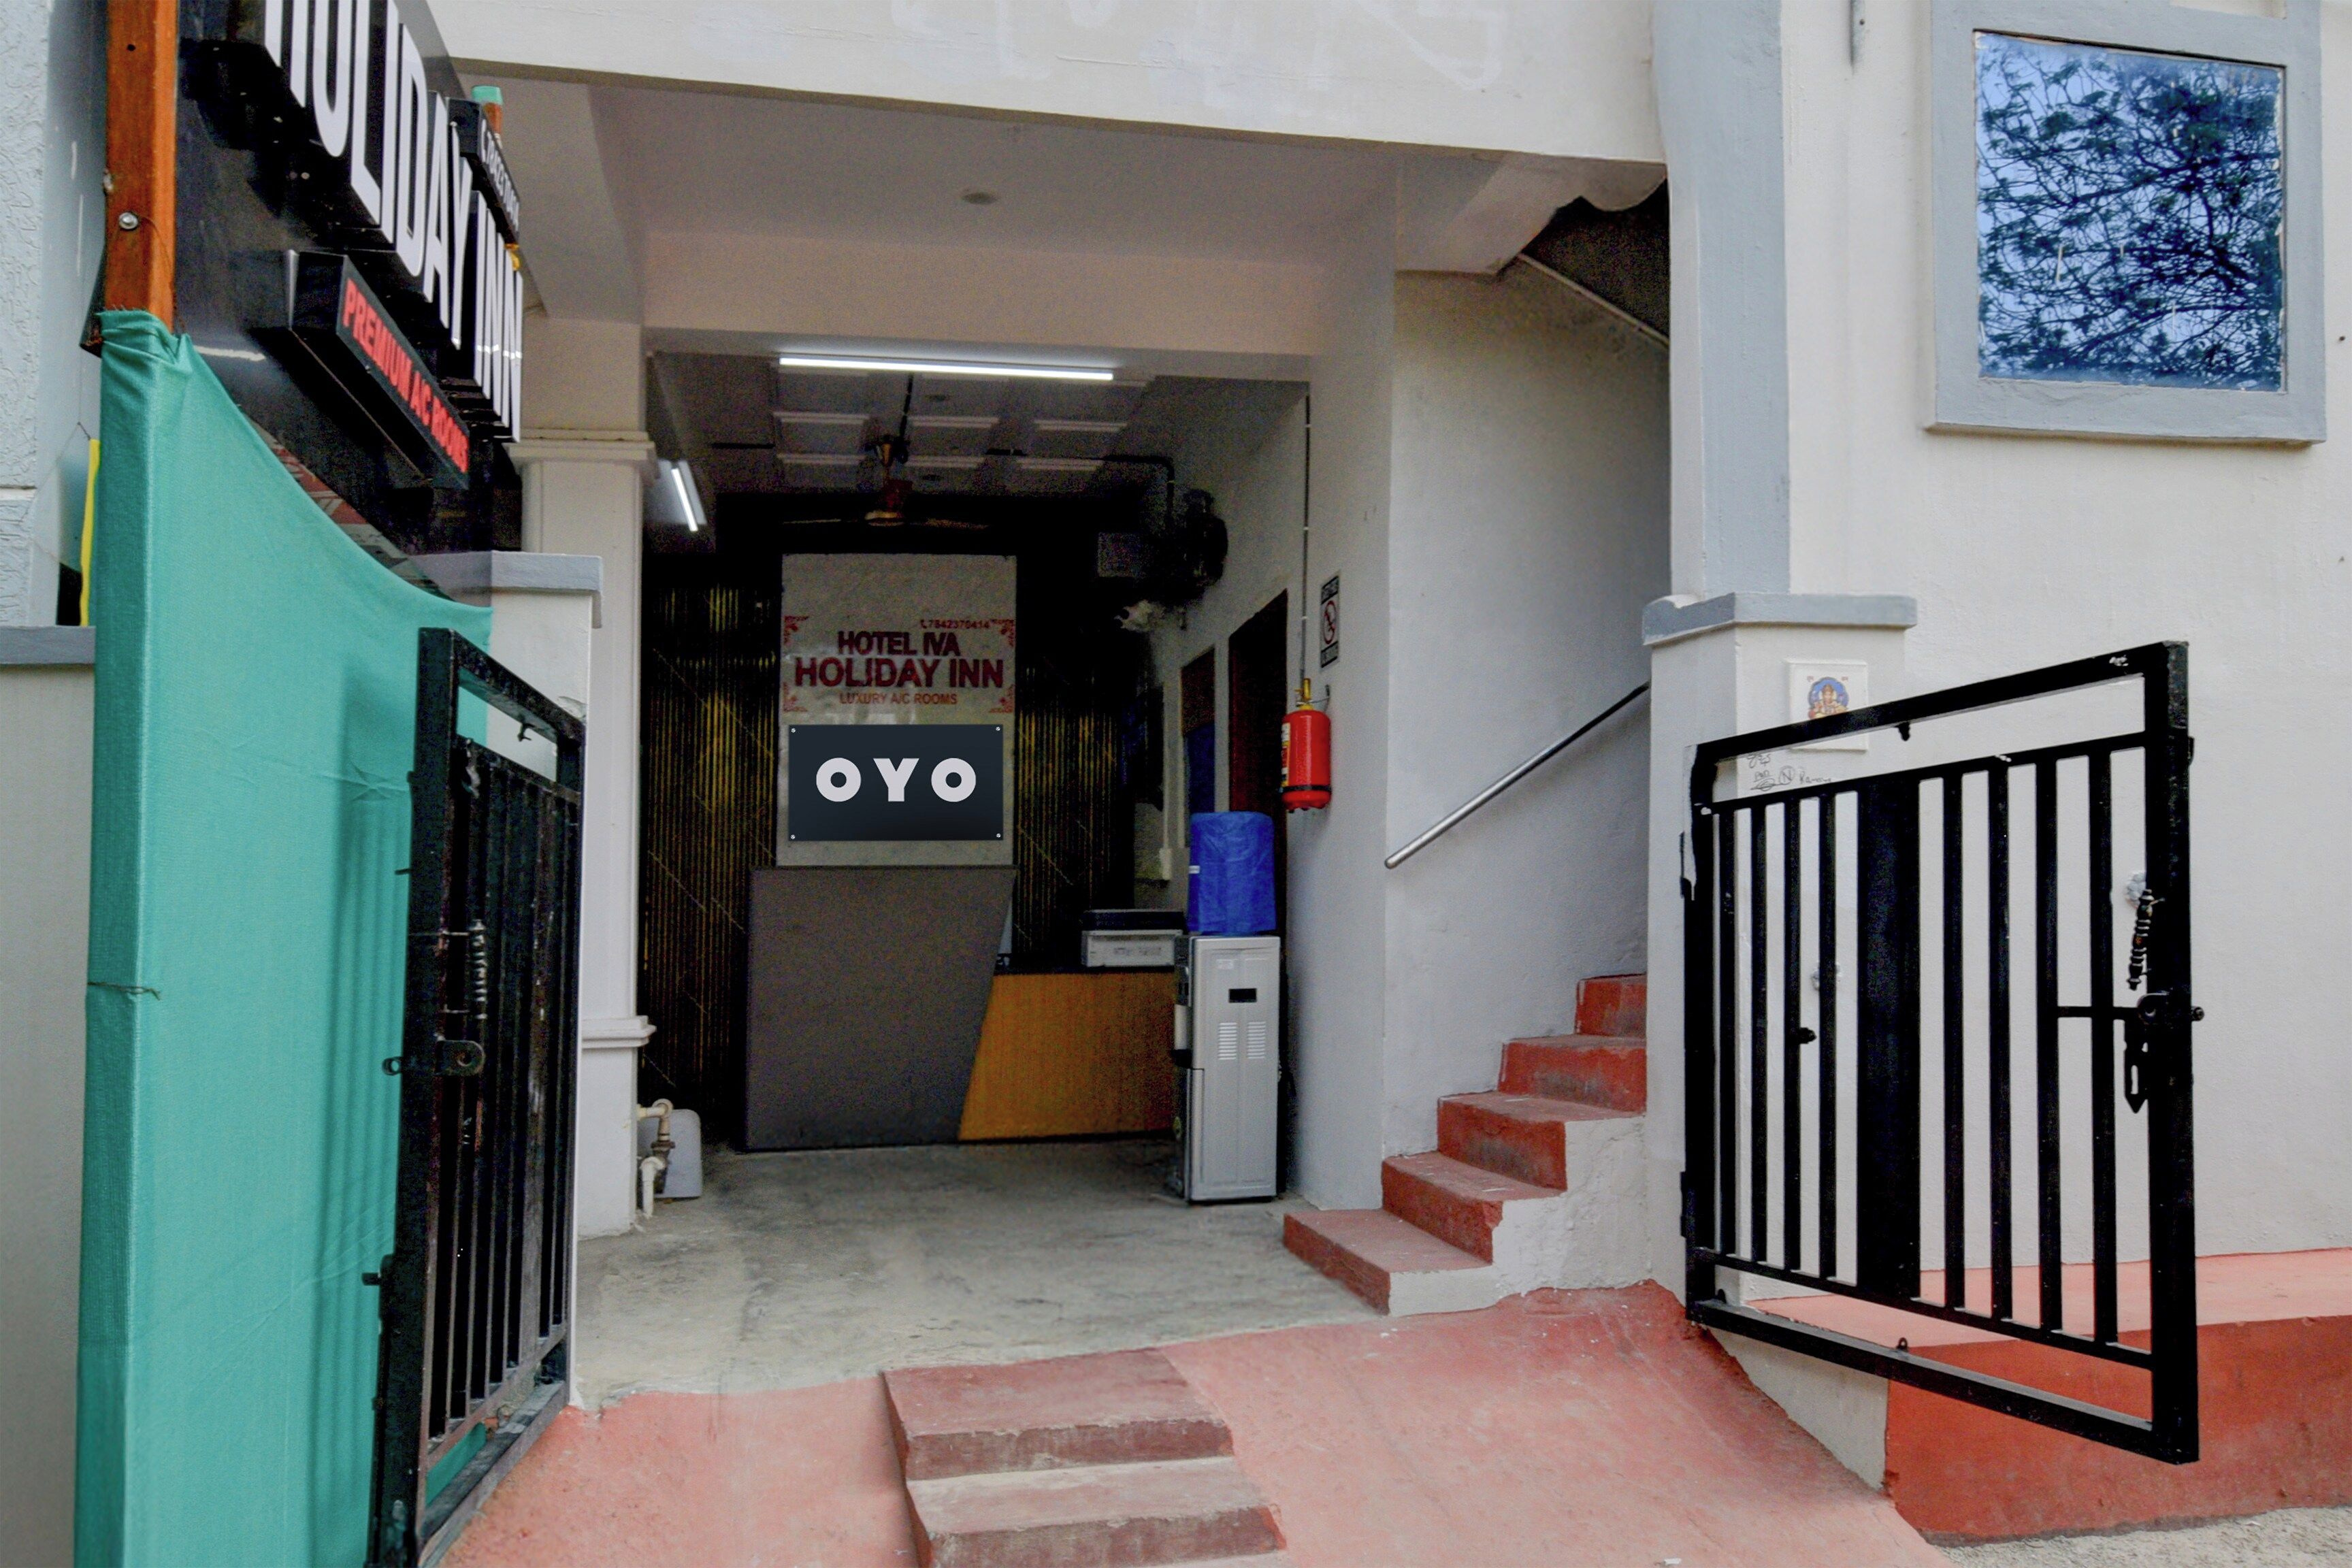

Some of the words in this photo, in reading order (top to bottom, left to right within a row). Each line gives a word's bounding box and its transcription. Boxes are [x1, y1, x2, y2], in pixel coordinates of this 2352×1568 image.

[474, 190, 523, 443] INN
[342, 278, 412, 403] PREMIUM
[837, 630, 917, 655] HOTEL
[794, 657, 941, 687] HOLIDAY
[949, 658, 1004, 688] INN
[839, 692, 887, 704] LUXURY
[914, 692, 958, 704] ROOMS
[816, 757, 977, 802] OYO
